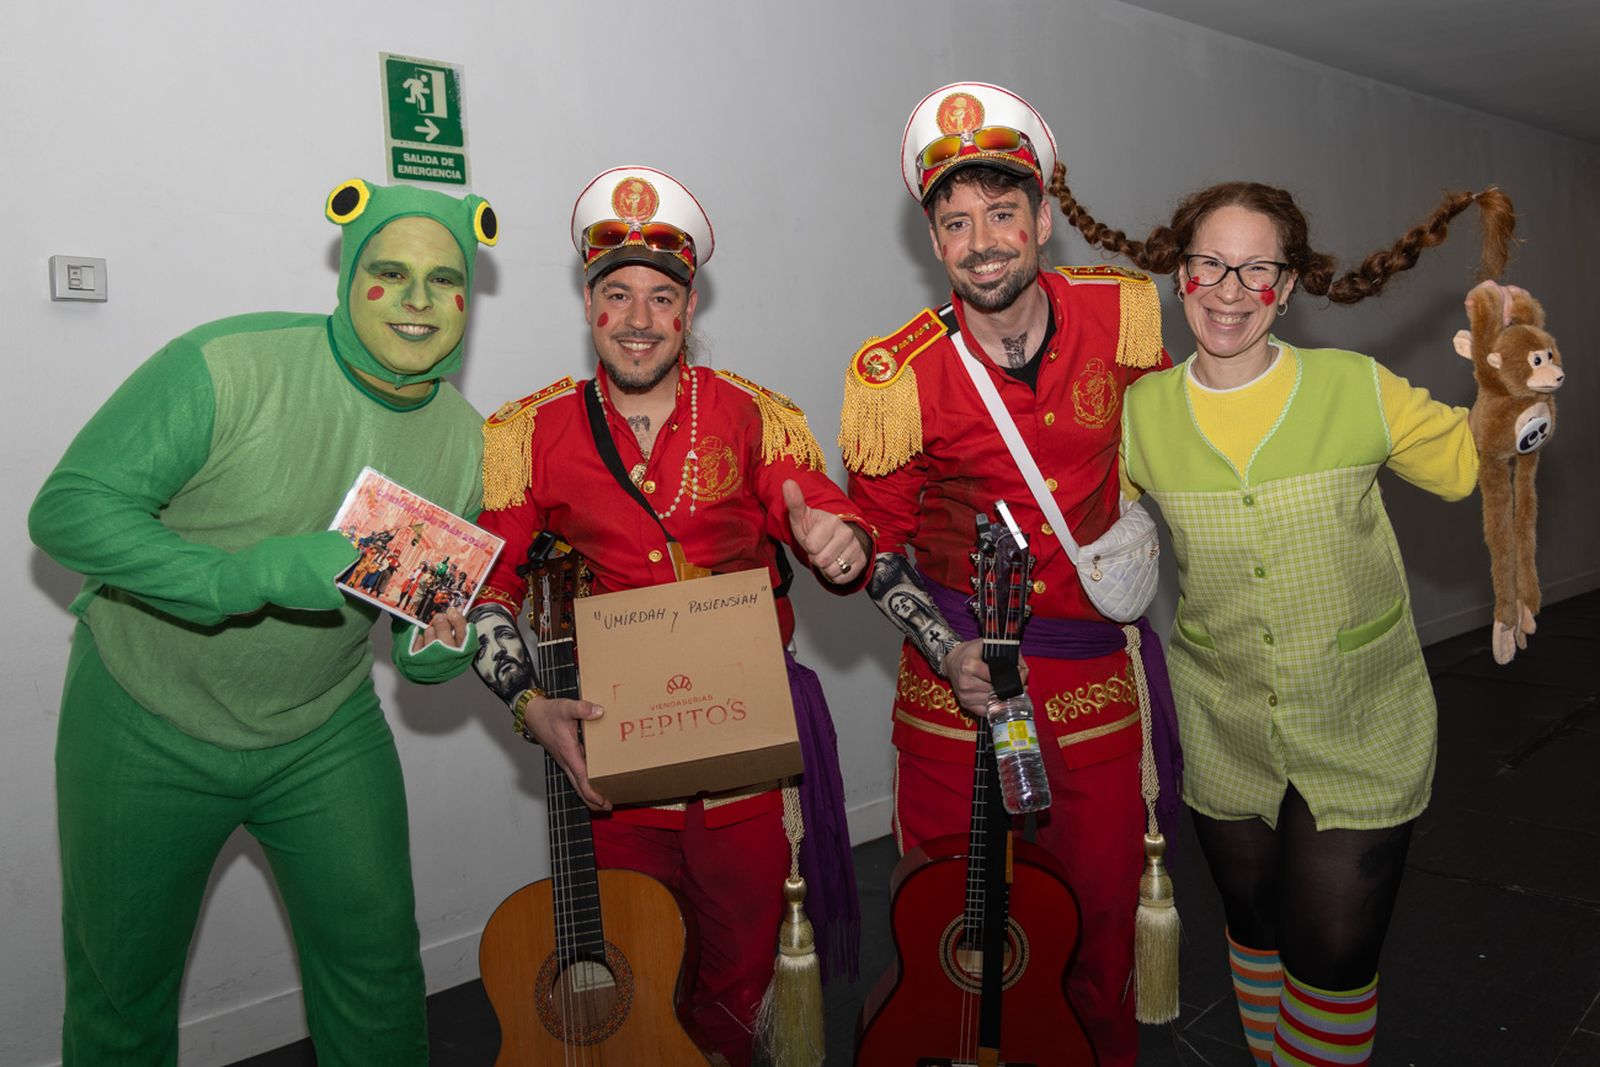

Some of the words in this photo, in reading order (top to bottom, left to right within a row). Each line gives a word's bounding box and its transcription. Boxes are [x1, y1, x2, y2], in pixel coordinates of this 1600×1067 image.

[403, 153, 439, 165] SALIDA
[441, 157, 455, 167] DE
[397, 164, 462, 179] EMERGENCIA
[620, 698, 747, 742] PEPITO'S
